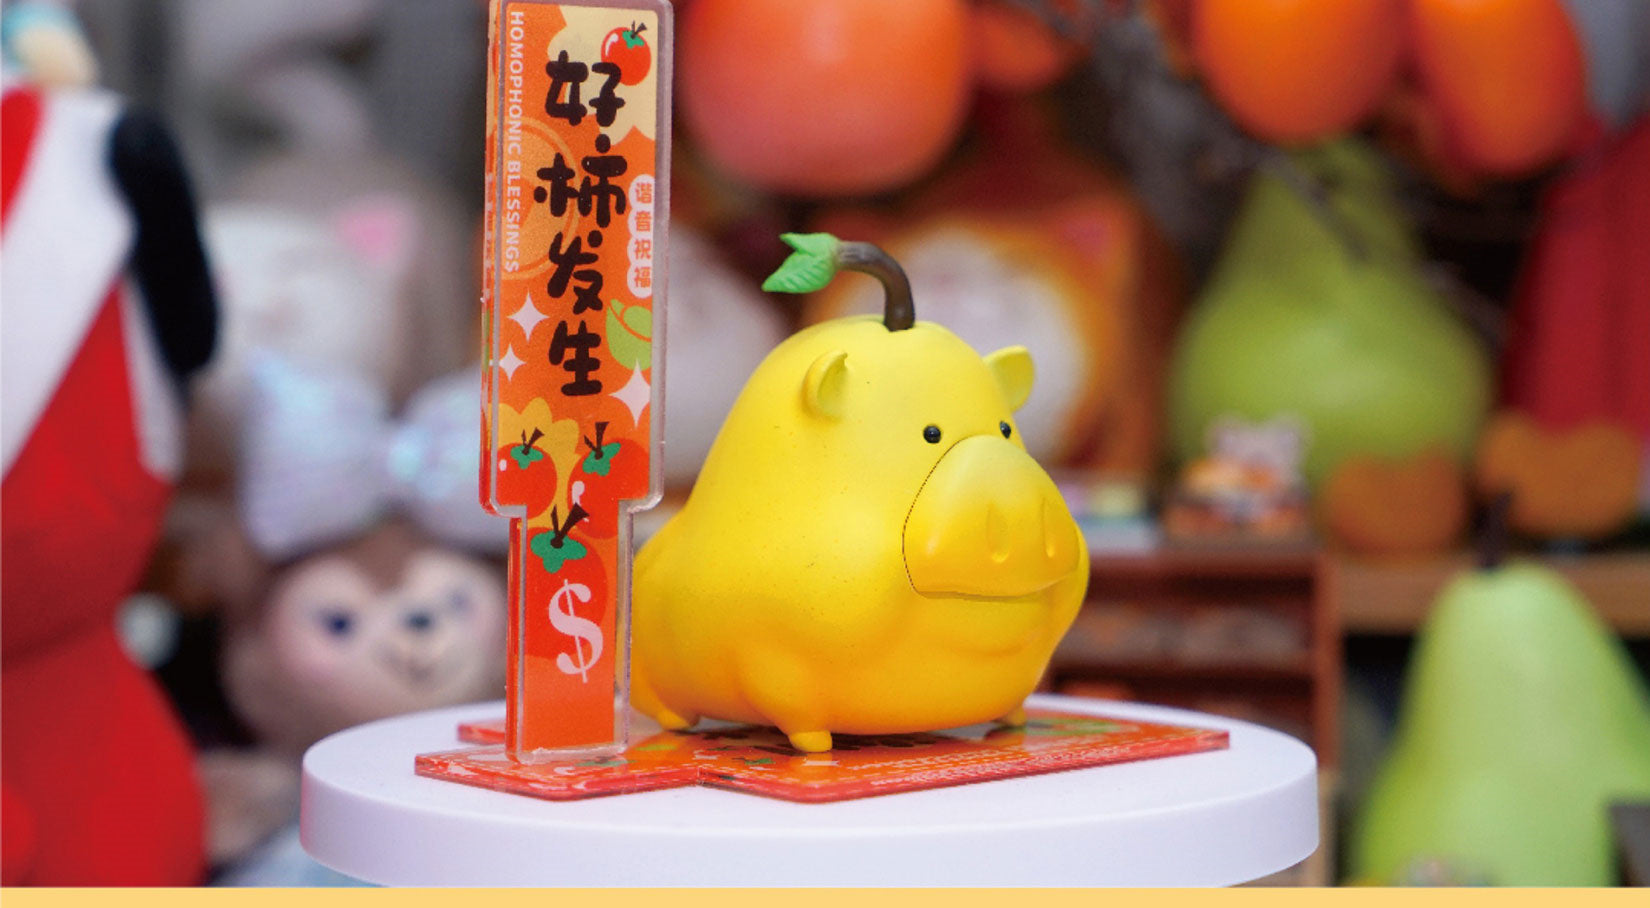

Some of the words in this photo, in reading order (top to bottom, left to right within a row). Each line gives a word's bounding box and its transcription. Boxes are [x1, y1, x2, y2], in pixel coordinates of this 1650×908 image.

[508, 11, 524, 155] HOMOPHONIC
[505, 160, 521, 272] BLESSINGS
[533, 50, 628, 396] 好柿发生
[634, 182, 653, 288] 谐音祝福
